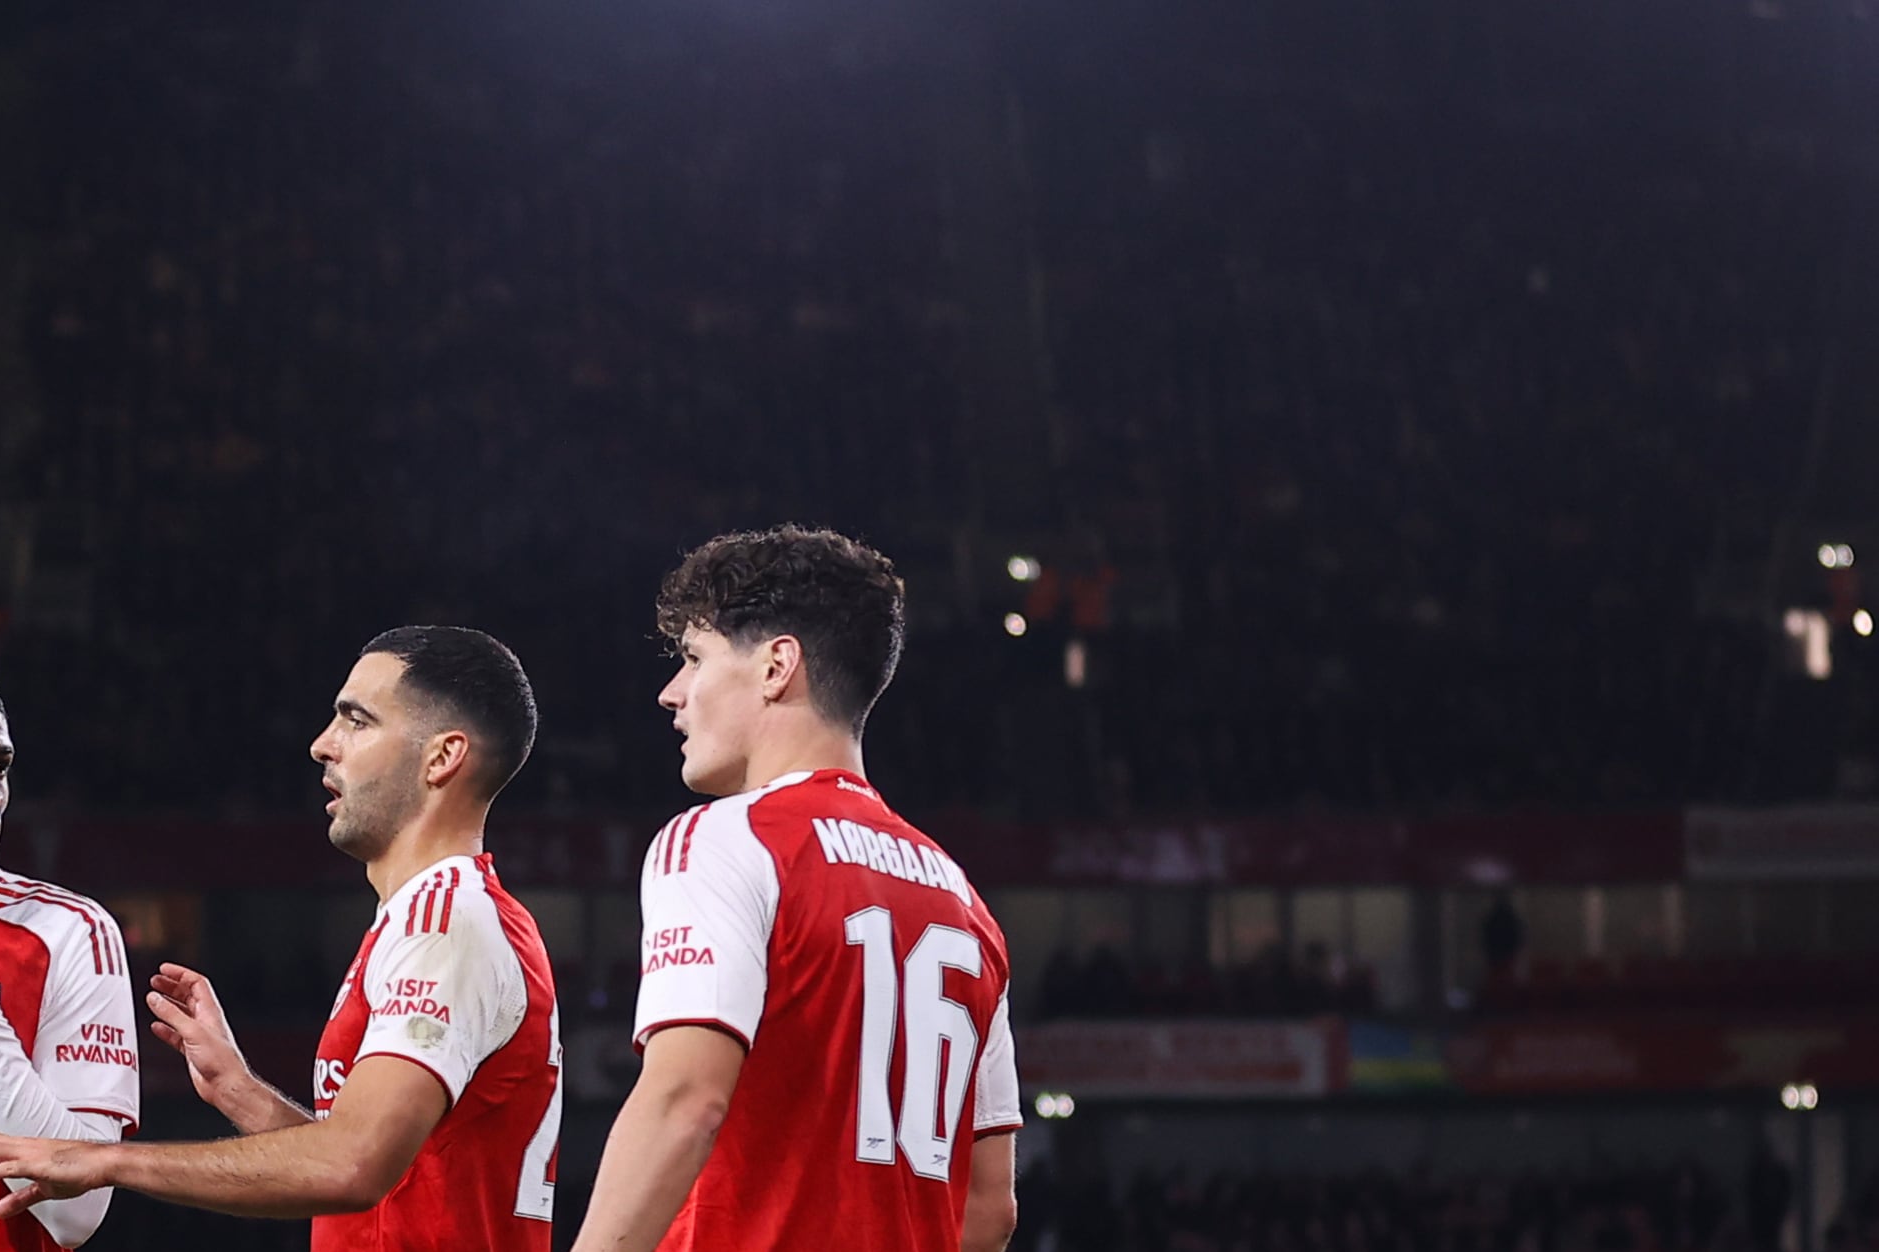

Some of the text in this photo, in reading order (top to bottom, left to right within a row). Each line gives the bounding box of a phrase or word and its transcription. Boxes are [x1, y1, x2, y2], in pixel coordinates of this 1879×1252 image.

[645, 925, 693, 950] ISIT
[641, 947, 715, 976] ANDA
[81, 1023, 125, 1046] VISIT
[844, 905, 982, 1182] 16
